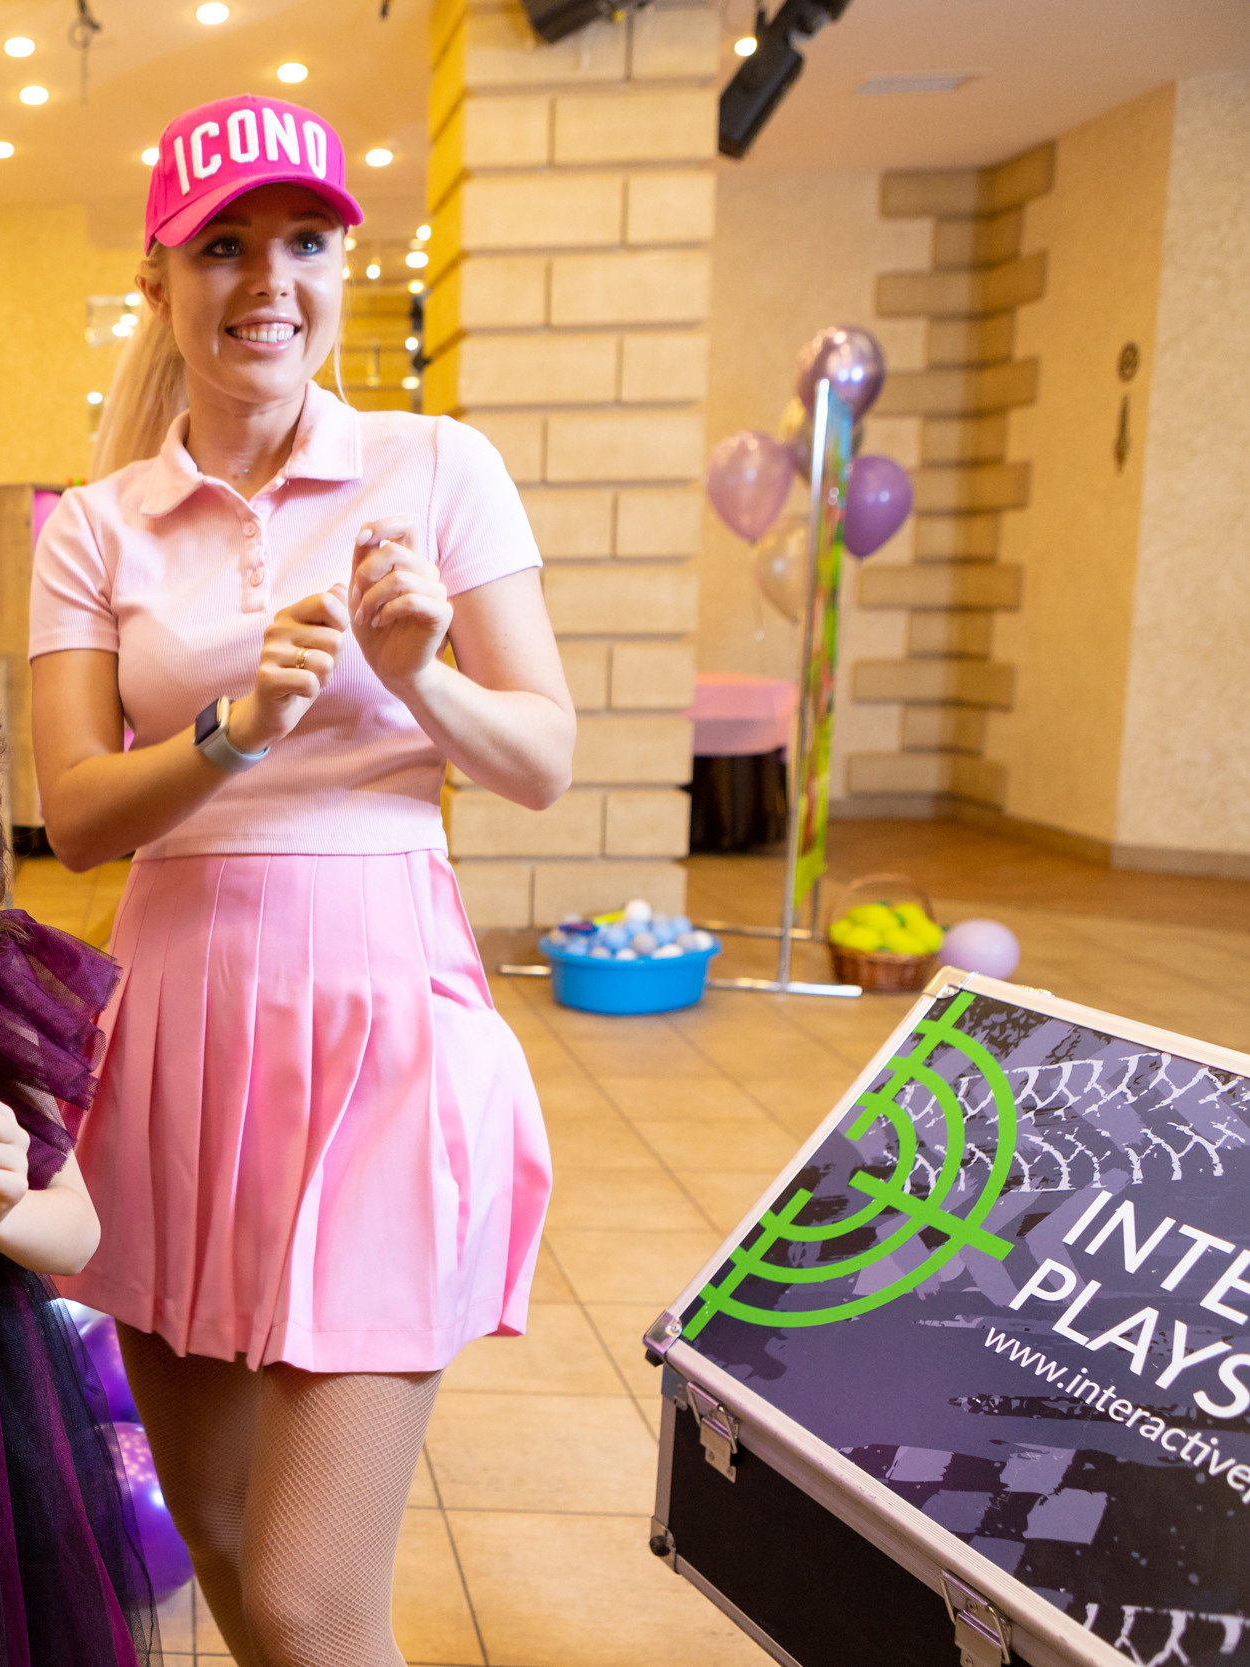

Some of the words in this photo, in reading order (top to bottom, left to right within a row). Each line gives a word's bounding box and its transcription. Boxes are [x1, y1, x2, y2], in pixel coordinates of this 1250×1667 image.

[1008, 1258, 1250, 1419] PLAYS
[1062, 1190, 1250, 1326] INTE
[984, 1327, 1250, 1504] www.interactive
